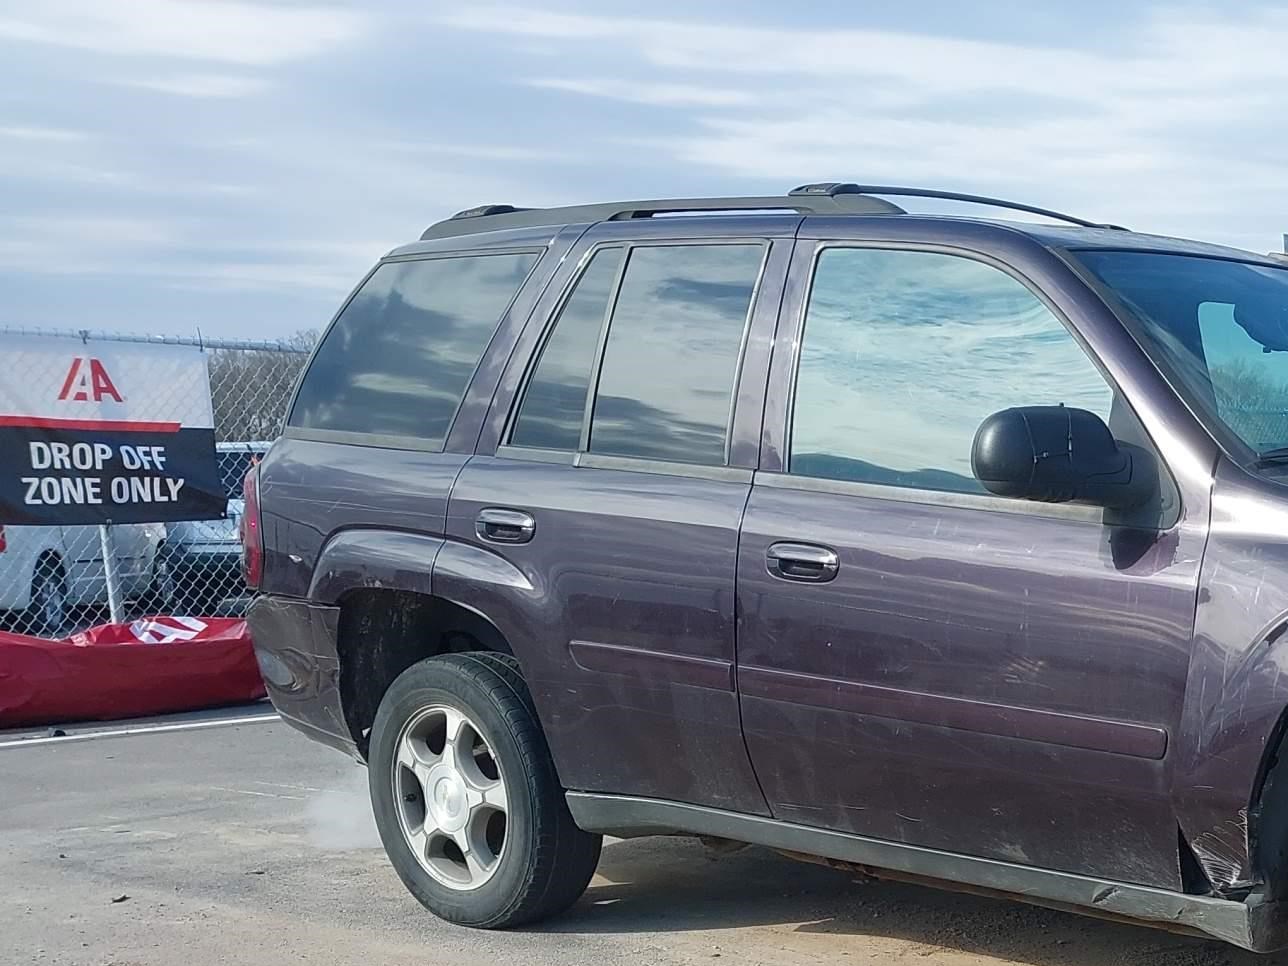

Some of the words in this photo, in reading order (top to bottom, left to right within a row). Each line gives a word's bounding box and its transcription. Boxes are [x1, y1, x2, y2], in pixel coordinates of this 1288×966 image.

[29, 441, 112, 470] DROP
[120, 445, 167, 471] OFF
[21, 477, 102, 505] ZONE
[111, 476, 184, 502] ONLY
